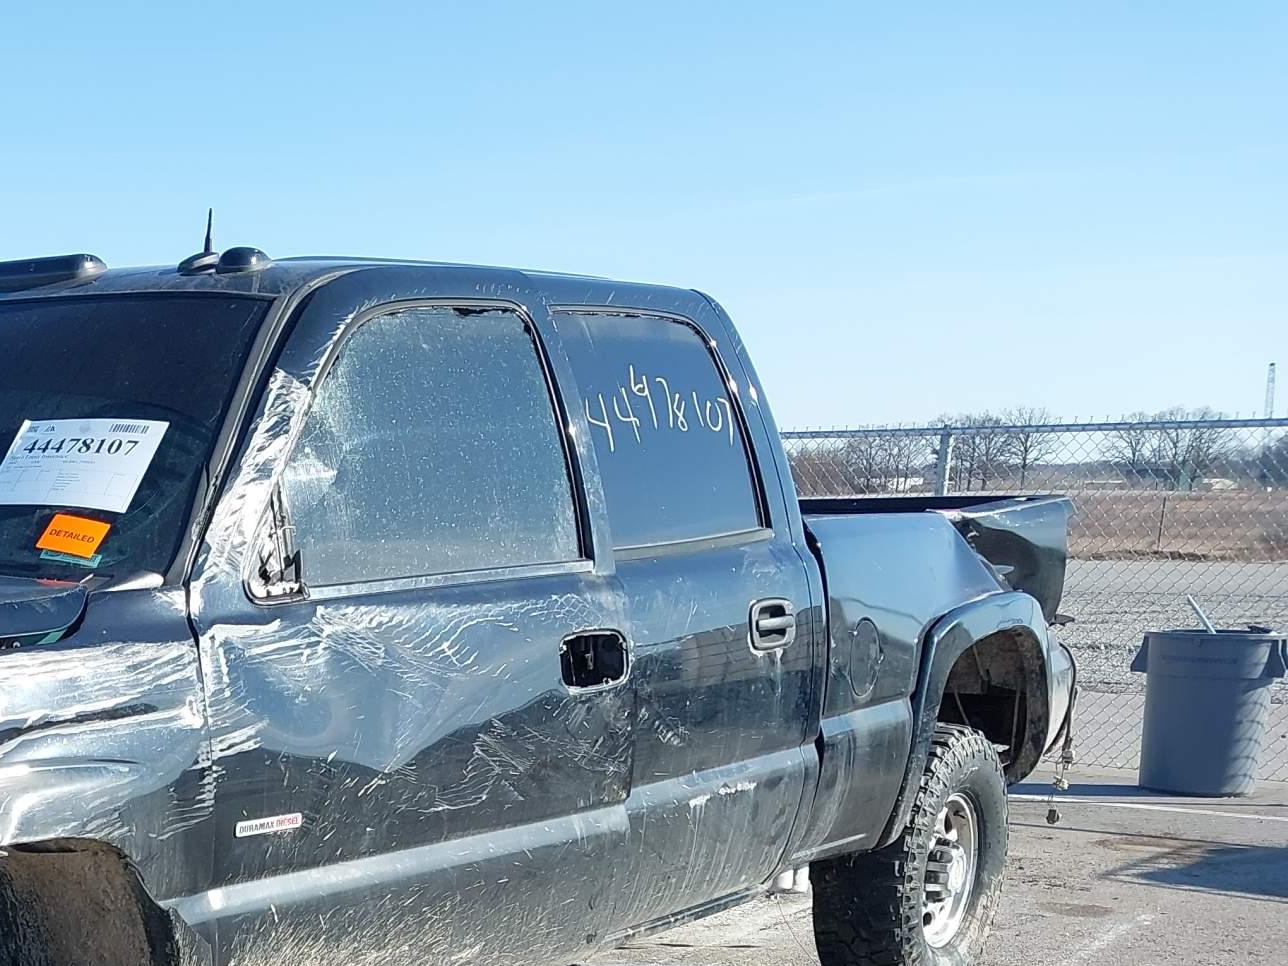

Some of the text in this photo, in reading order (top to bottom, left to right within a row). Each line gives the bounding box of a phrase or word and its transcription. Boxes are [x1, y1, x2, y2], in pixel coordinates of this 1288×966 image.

[23, 437, 141, 456] 44478107
[49, 528, 95, 543] DETAILED
[239, 820, 275, 834] DURAMAX
